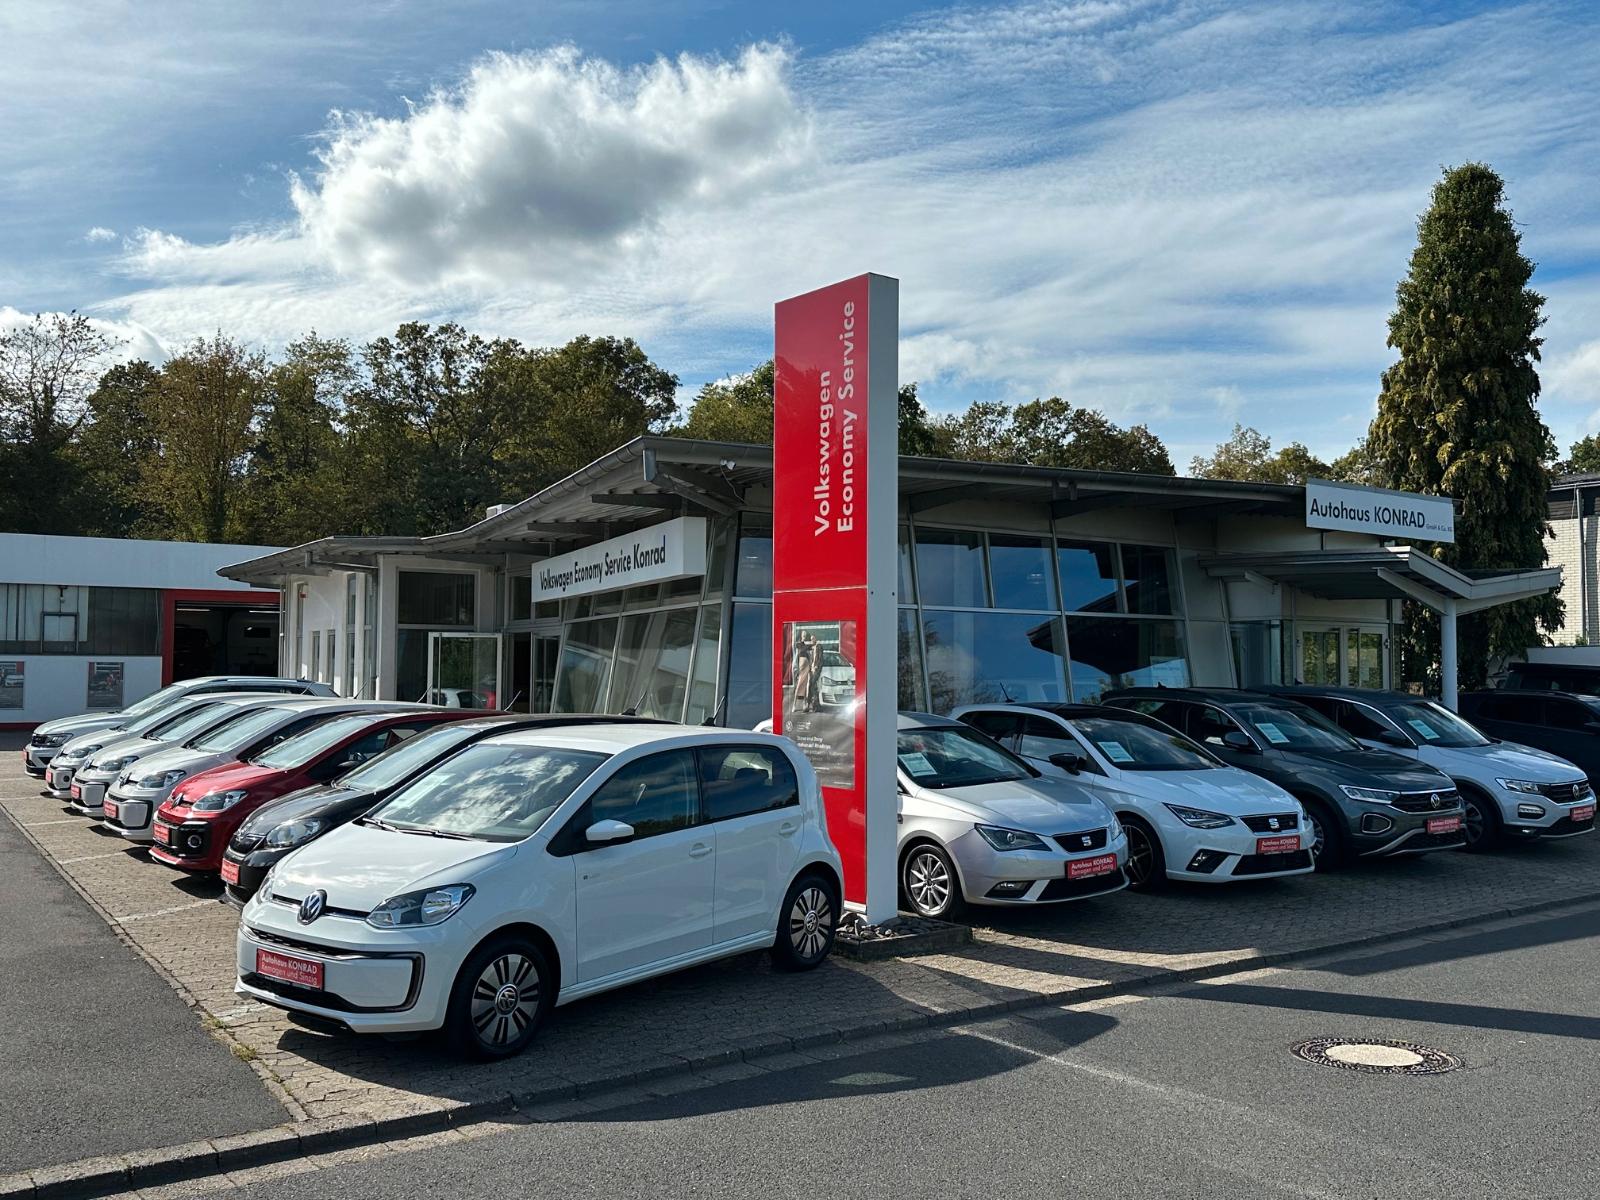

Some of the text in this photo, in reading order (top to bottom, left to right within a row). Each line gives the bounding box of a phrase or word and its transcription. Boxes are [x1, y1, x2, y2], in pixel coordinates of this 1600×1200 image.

[837, 300, 858, 533] Economy Service
[814, 370, 834, 536] Volkswagen
[1310, 498, 1425, 528] Autohaus KONRAD
[540, 535, 666, 592] Volkswagen Economy Service Konrad
[1071, 856, 1113, 869] Autohaus KONRAD
[261, 953, 317, 974] Autohaus KONRAD
[262, 961, 286, 976] Remagen
[287, 969, 298, 980] und
[300, 971, 317, 986] Sinzig
